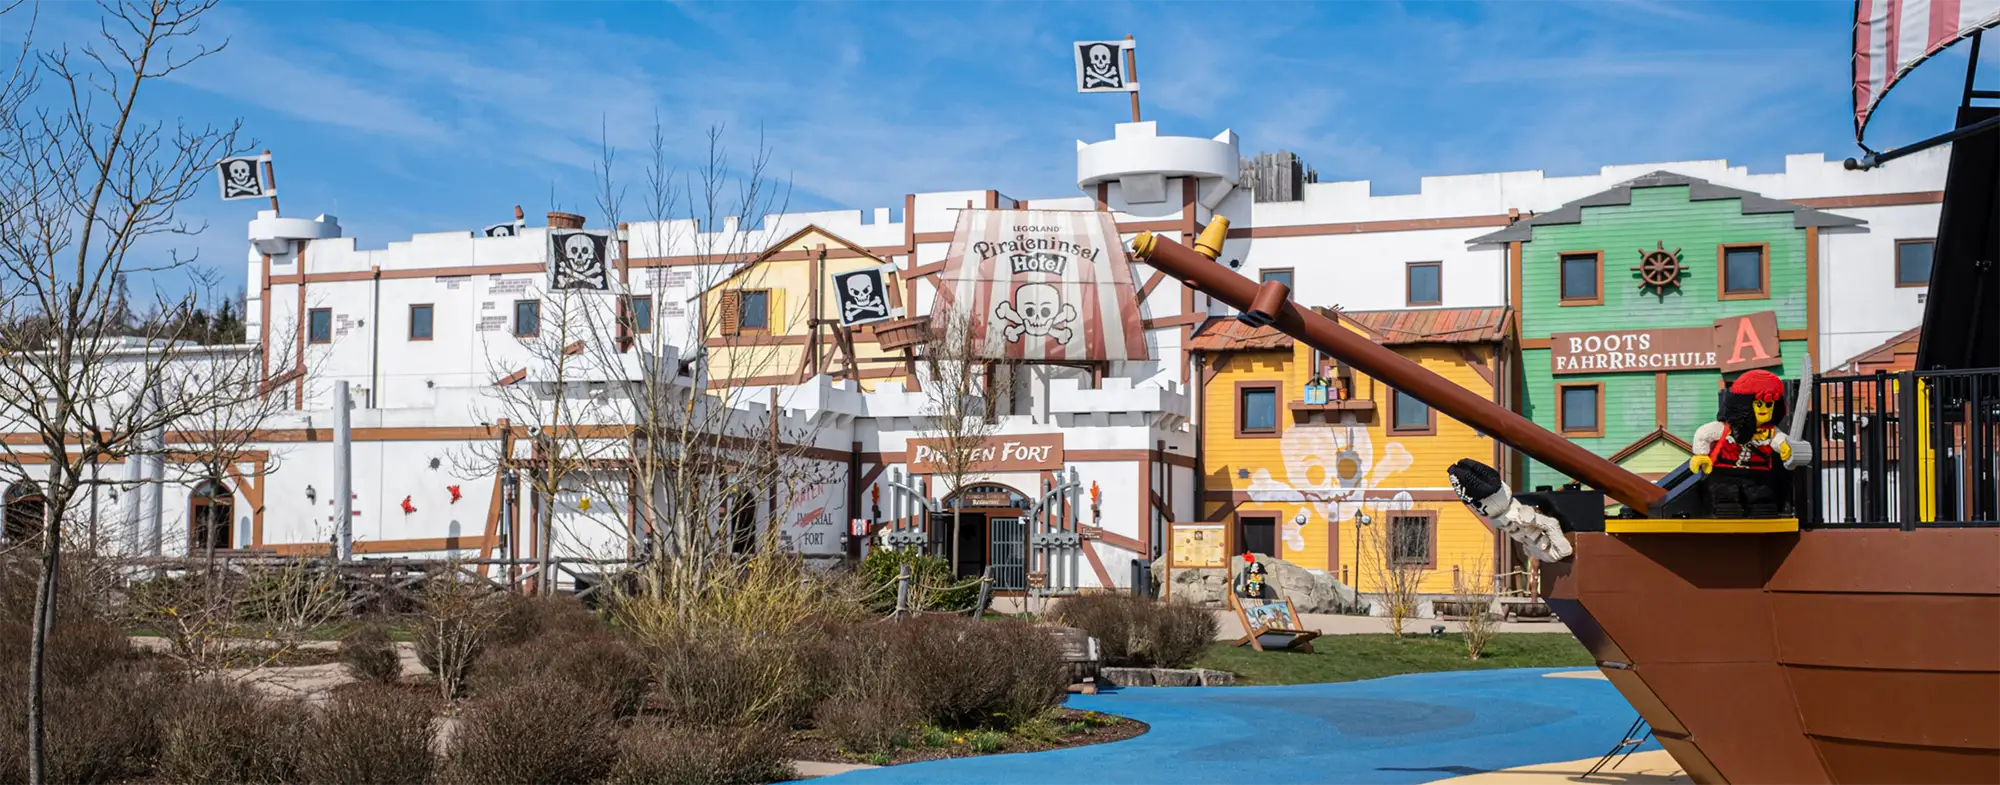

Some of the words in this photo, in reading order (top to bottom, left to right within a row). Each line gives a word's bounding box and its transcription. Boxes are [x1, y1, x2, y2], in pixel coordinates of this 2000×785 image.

[973, 234, 1100, 263] Pirateninsel
[1011, 253, 1066, 274] Hotel
[1569, 334, 1650, 353] BOOTS
[1727, 317, 1771, 364] A
[1556, 352, 1717, 370] FAHRRRSCHULE
[913, 445, 996, 465] PIRTEN
[1001, 441, 1053, 462] FORT
[804, 533, 824, 545] FORT
